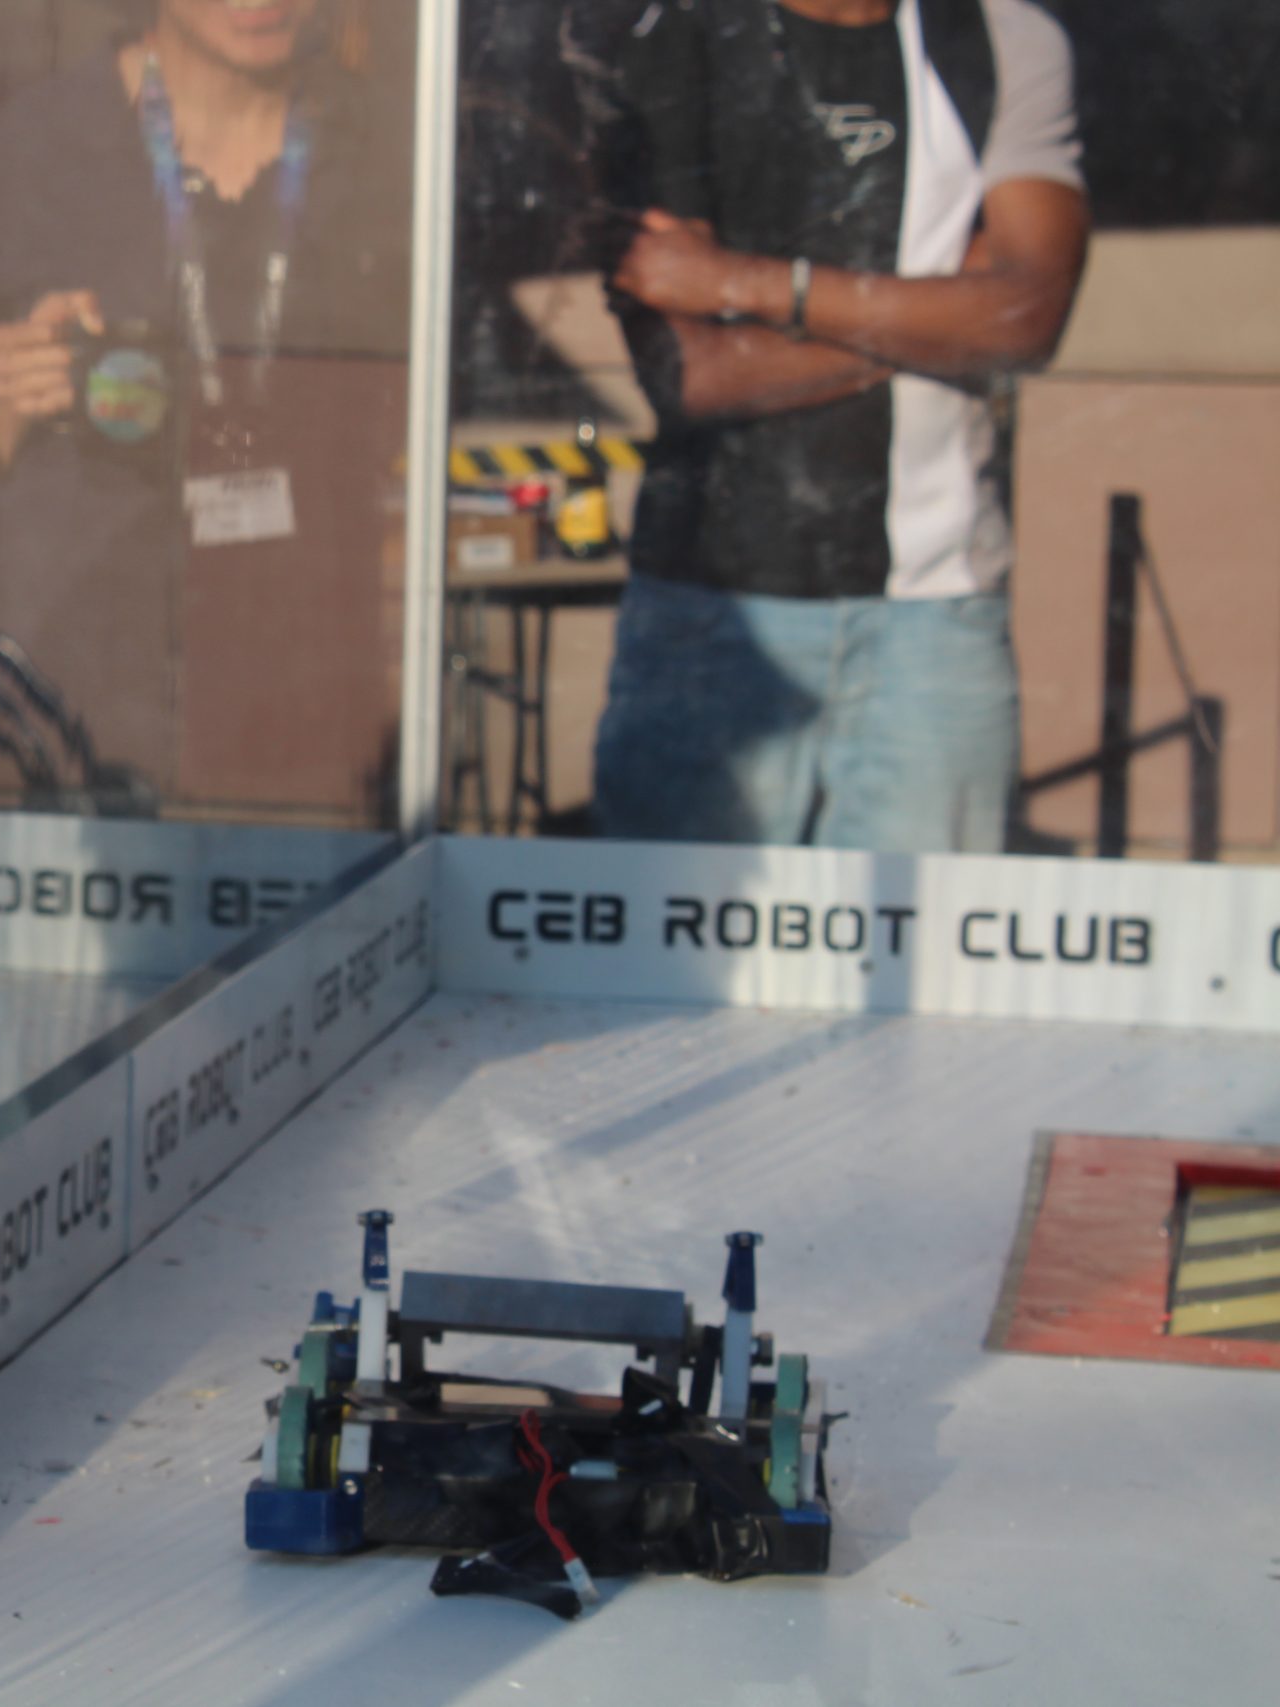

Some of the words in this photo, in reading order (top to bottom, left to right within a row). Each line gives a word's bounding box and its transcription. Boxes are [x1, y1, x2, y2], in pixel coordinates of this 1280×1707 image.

[487, 889, 627, 944] CEB
[664, 897, 916, 955] ROBOT
[961, 912, 1152, 966] CLUB
[58, 1137, 111, 1236] CLUB
